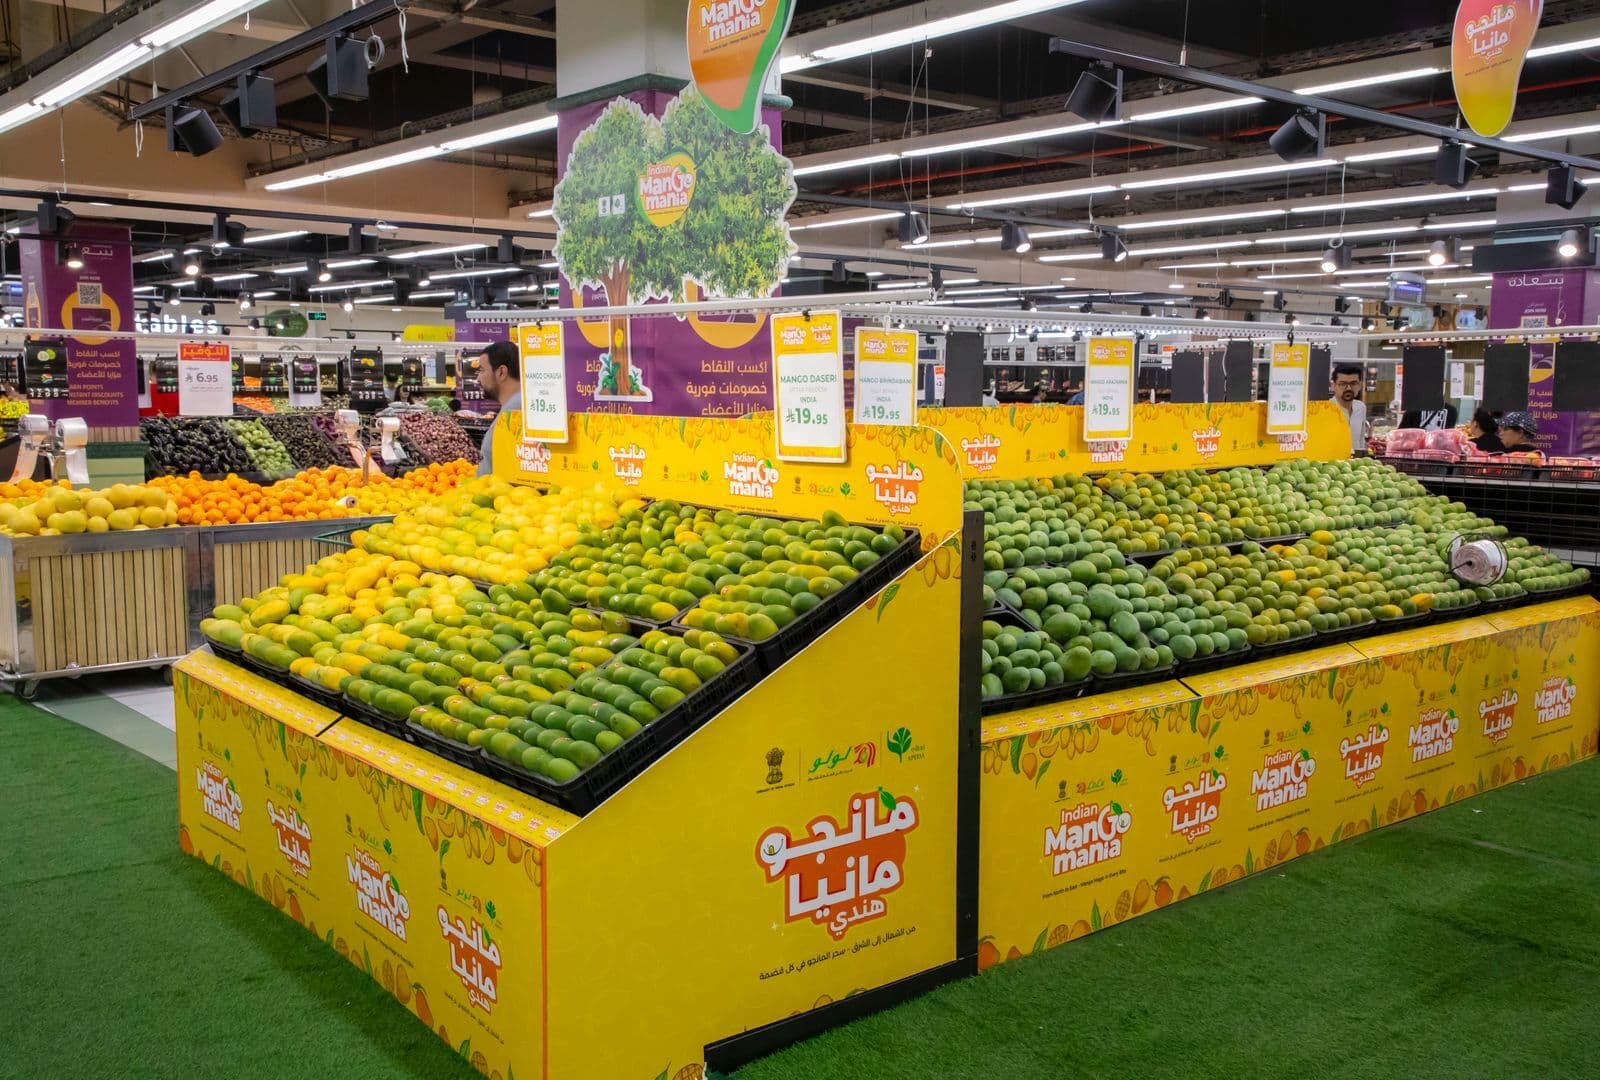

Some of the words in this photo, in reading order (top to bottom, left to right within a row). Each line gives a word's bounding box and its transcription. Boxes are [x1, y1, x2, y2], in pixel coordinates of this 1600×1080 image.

[709, 11, 760, 41] mania
[1466, 7, 1515, 39] مانجو
[1473, 31, 1508, 55] مانيا
[645, 191, 688, 210] mania
[701, 360, 734, 373] النقاط
[737, 361, 768, 375] اكسب
[196, 372, 218, 383] 6.95
[780, 374, 809, 384] MANGO
[810, 374, 836, 383] DASERI
[686, 381, 716, 398] فورية
[719, 381, 767, 395] خصومات
[535, 398, 556, 413] 19.95
[800, 396, 817, 404] INDIA
[796, 408, 828, 424] 19.95
[871, 406, 900, 419] 19.95
[1098, 404, 1120, 416] 19.95
[962, 434, 1000, 452] مانجو
[1192, 428, 1222, 441] مانجو
[608, 444, 646, 462] مانجو
[1196, 440, 1218, 453] مانيا
[1280, 441, 1304, 452] mania
[520, 458, 548, 473] mania
[733, 453, 756, 462] Indian
[967, 450, 996, 467] مانيا
[1091, 452, 1124, 463] mania
[614, 461, 642, 479] مانيا
[866, 461, 923, 483] مانجو
[730, 480, 773, 498] mania
[875, 484, 916, 505] مانيا
[889, 504, 910, 514] هندي
[1543, 678, 1562, 688] Indian
[1479, 690, 1518, 718] مانجو
[1419, 710, 1442, 723] Indian
[1538, 703, 1571, 724] mania
[1484, 714, 1512, 737] مانيا
[1340, 726, 1390, 758] مانجو
[1412, 737, 1453, 762] mania
[1264, 751, 1292, 766] Indian
[1346, 752, 1382, 780] مانيا
[1358, 771, 1376, 786] هندي
[1163, 772, 1226, 811] مانجو
[1256, 781, 1307, 812] mania
[204, 796, 240, 832] mania
[267, 801, 312, 841] مانجو
[1061, 804, 1098, 824] Indian
[1172, 802, 1218, 834] مانيا
[760, 798, 916, 878] مانجو
[1188, 824, 1210, 841] هندي
[278, 827, 311, 870] مانيا
[1054, 839, 1121, 875] mania
[354, 847, 381, 874] Indian
[789, 854, 900, 920] مانيا
[356, 889, 407, 942] mania
[830, 899, 884, 936] هندي
[438, 906, 501, 967] مانجو
[883, 927, 905, 944] الشمال
[906, 924, 917, 936] من
[850, 938, 871, 955] الشرق
[872, 934, 883, 948] إلى
[806, 952, 831, 969] المانجو
[830, 947, 846, 961] سحر
[450, 942, 497, 1001] مانيا
[785, 962, 795, 975] كل
[796, 960, 806, 974] في
[468, 989, 491, 1013] هندي
